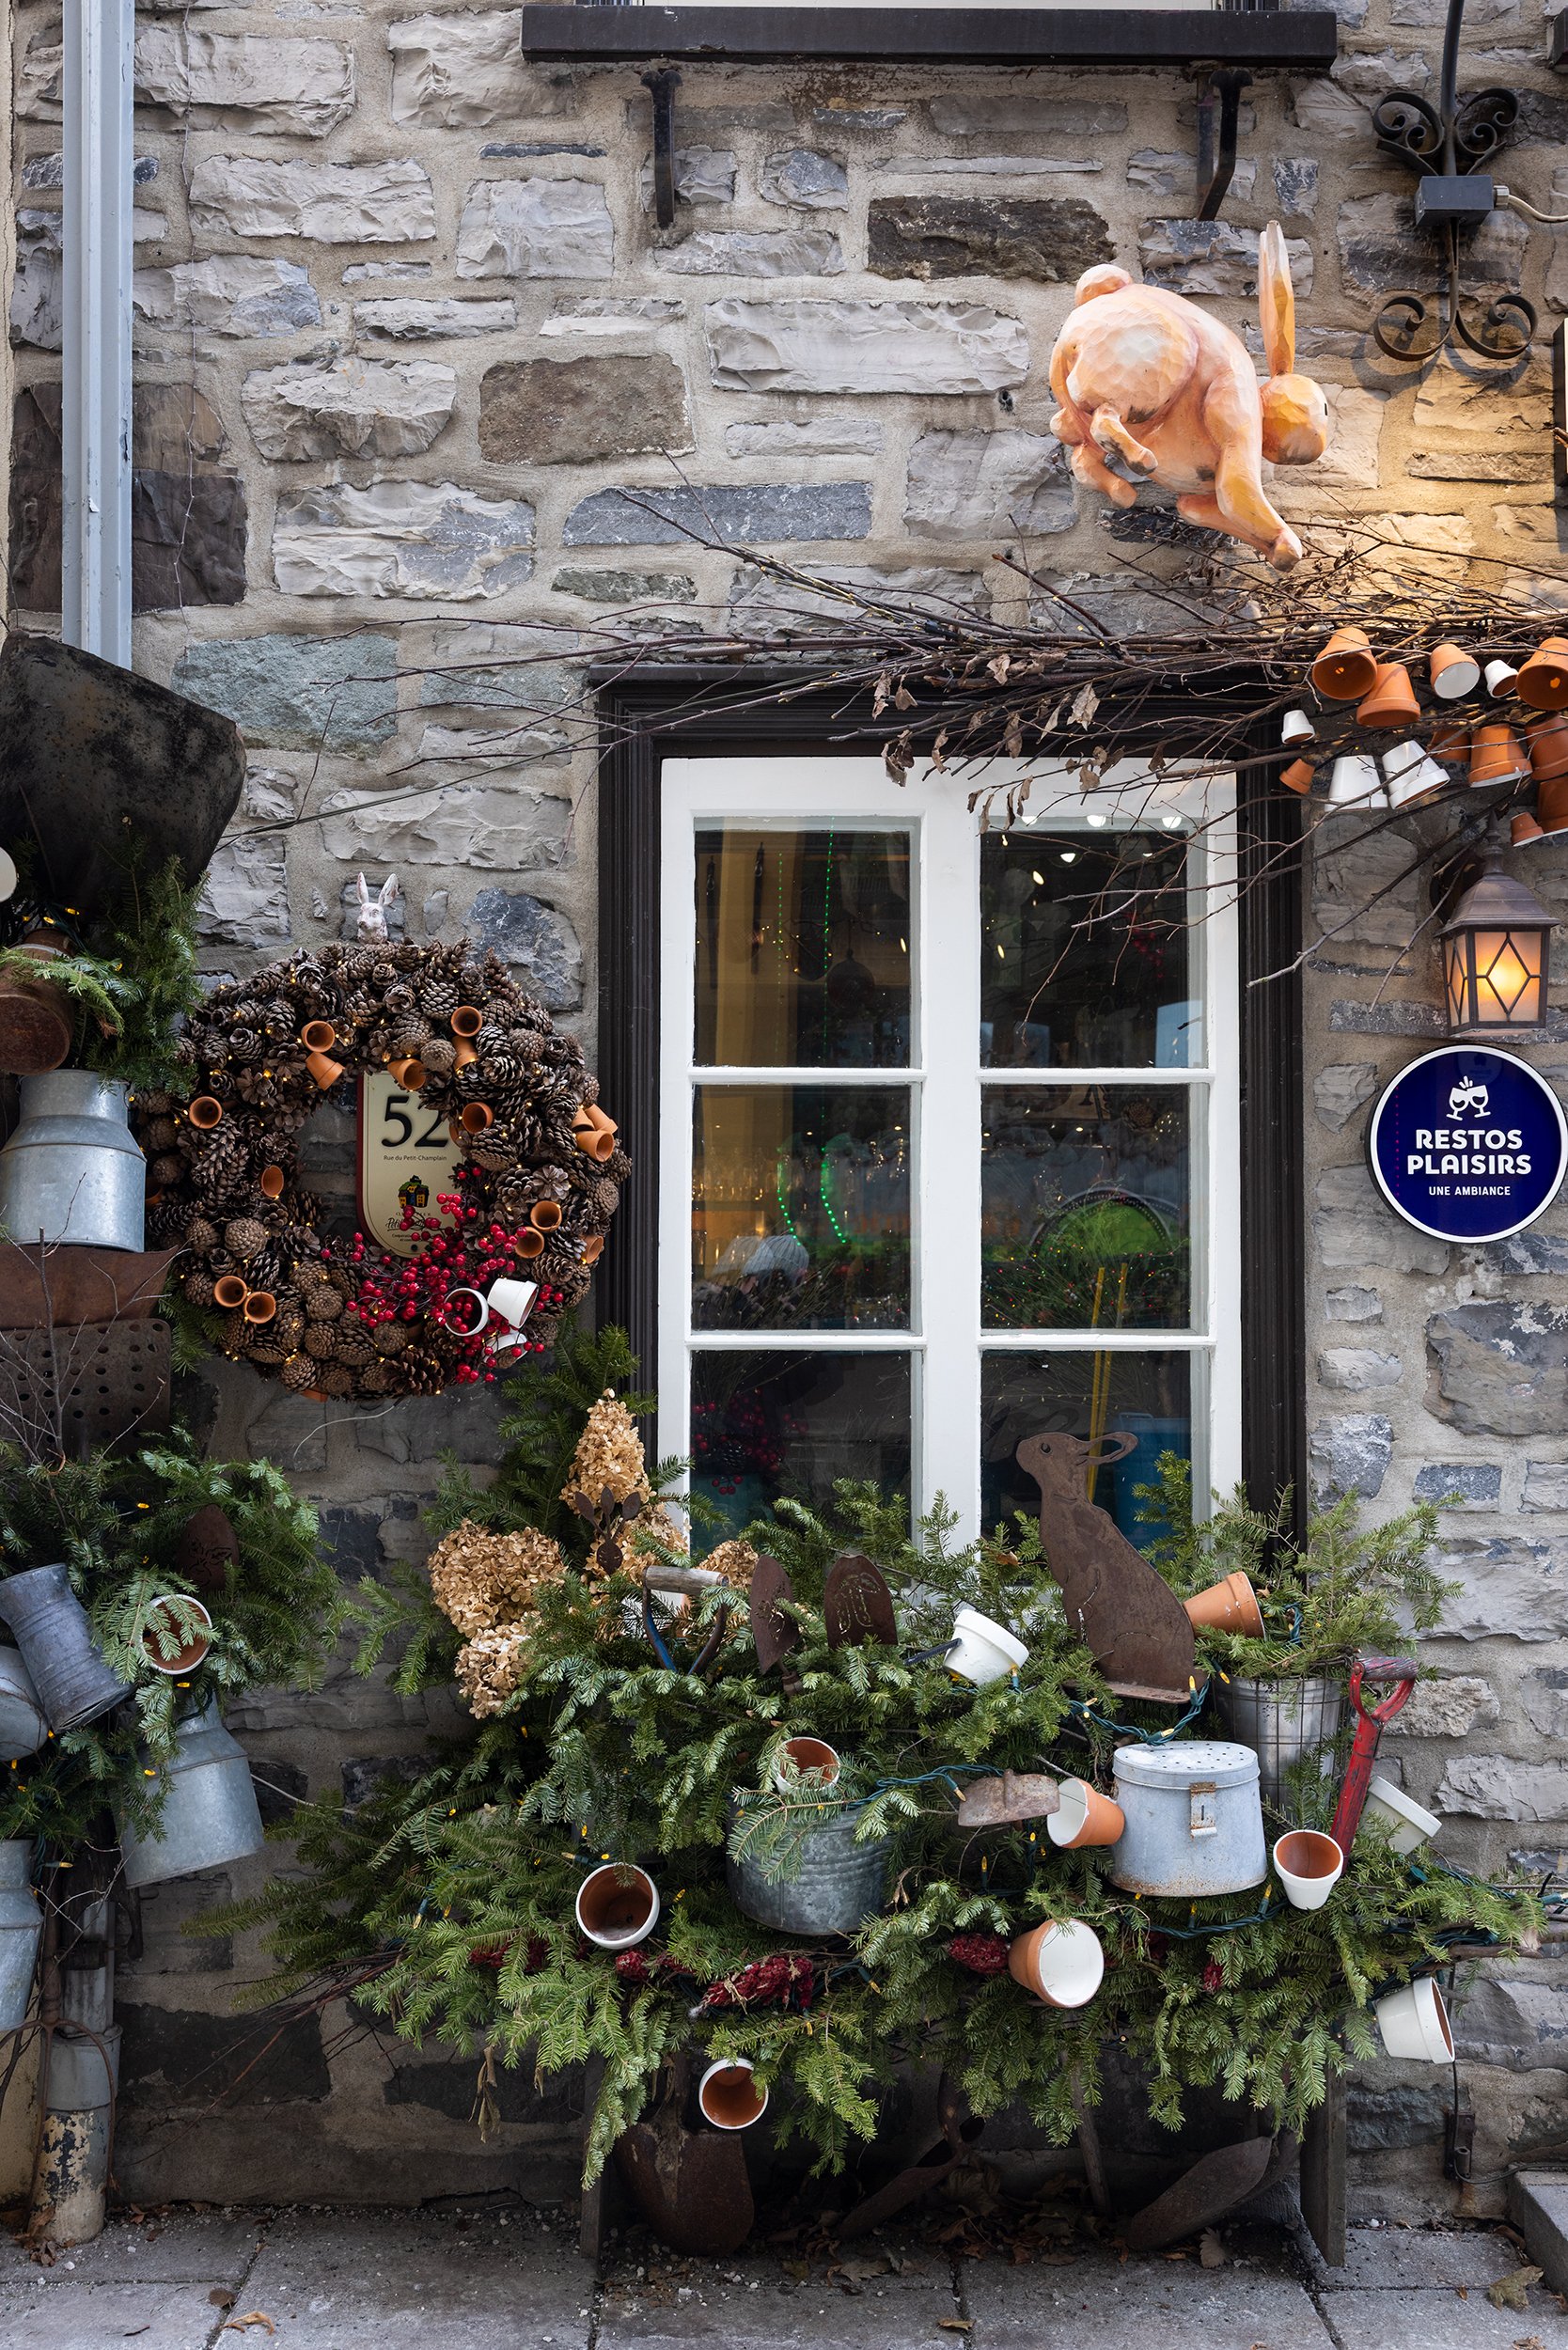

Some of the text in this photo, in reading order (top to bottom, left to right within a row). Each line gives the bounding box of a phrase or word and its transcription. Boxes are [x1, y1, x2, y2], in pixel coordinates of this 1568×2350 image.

[381, 1096, 448, 1147] 52
[1416, 1129, 1523, 1150] RESTOS
[1407, 1154, 1532, 1175] PLAISIRS
[1428, 1185, 1511, 1196] UNE AMBIANCE
